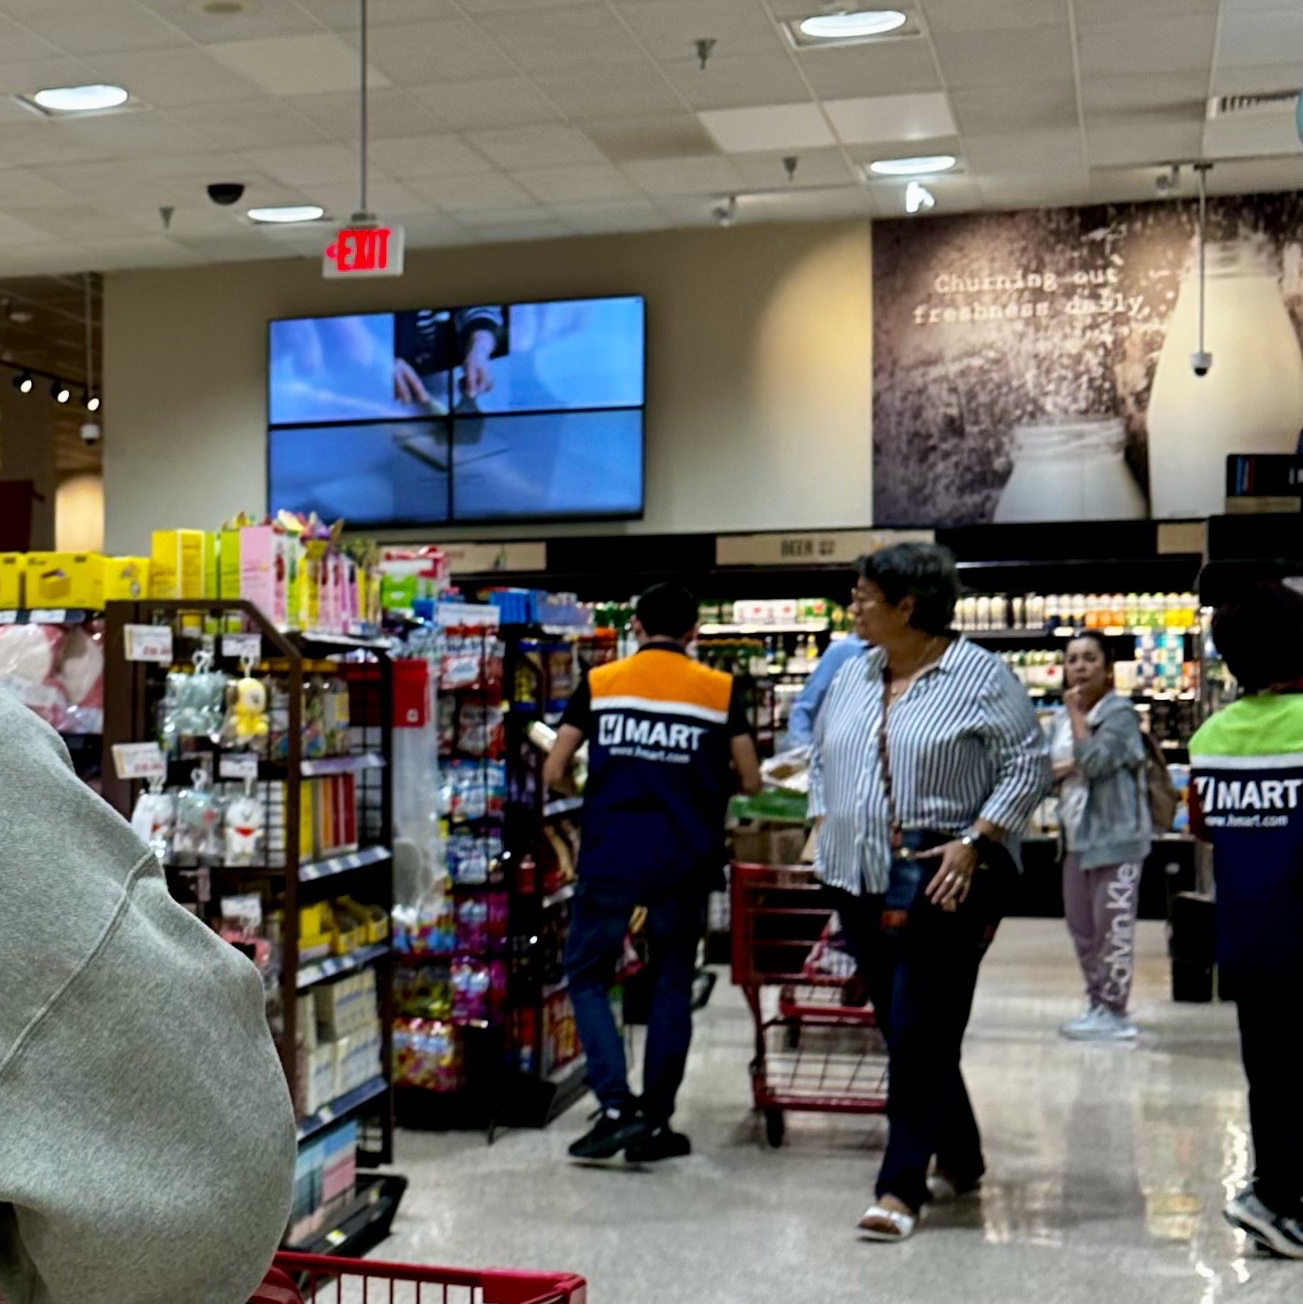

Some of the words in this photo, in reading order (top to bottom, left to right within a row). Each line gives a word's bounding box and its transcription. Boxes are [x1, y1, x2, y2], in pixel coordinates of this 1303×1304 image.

[337, 226, 392, 273] EXIT
[934, 269, 1059, 294] Churning
[1072, 266, 1119, 286] out
[912, 301, 1050, 325] freshness
[625, 717, 707, 751] MART
[1216, 779, 1303, 810] MART
[1099, 913, 1134, 1001] Calvin
